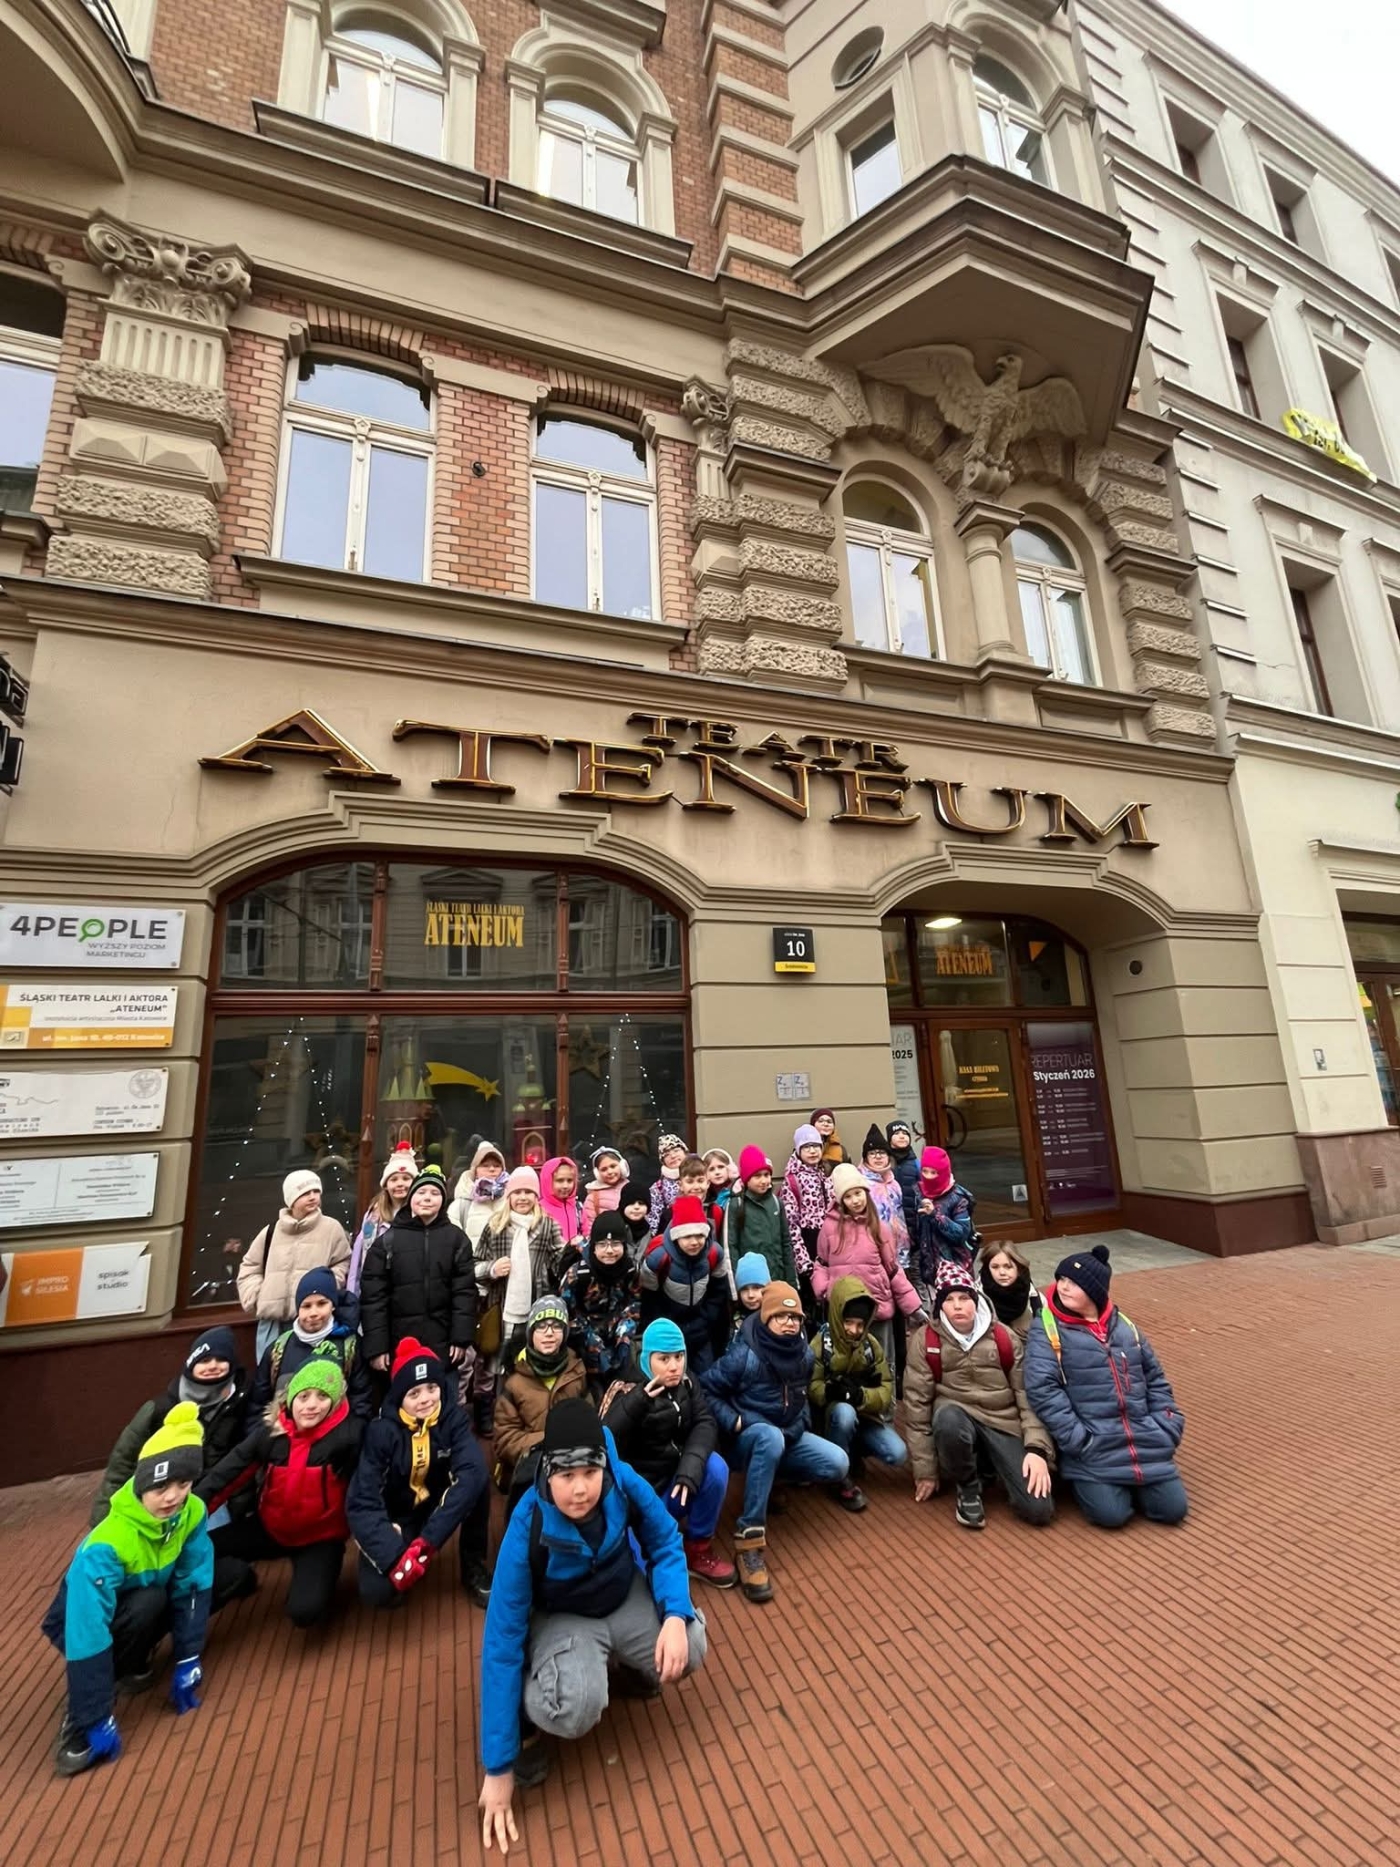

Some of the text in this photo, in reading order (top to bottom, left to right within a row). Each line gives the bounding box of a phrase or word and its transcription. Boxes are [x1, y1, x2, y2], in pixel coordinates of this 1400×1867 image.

[626, 712, 908, 772] TEATR
[197, 708, 1160, 851] ATENEUM
[424, 913, 525, 948] ATENEUM
[787, 940, 805, 957] 10
[20, 993, 57, 1003] ŚLĄSKI
[59, 994, 91, 1002] TEATR
[93, 994, 122, 1002] LALKI
[129, 994, 168, 1002] AKTORA
[1033, 1068, 1096, 1084] Styczeń 2026
[97, 1282, 129, 1290] studio
